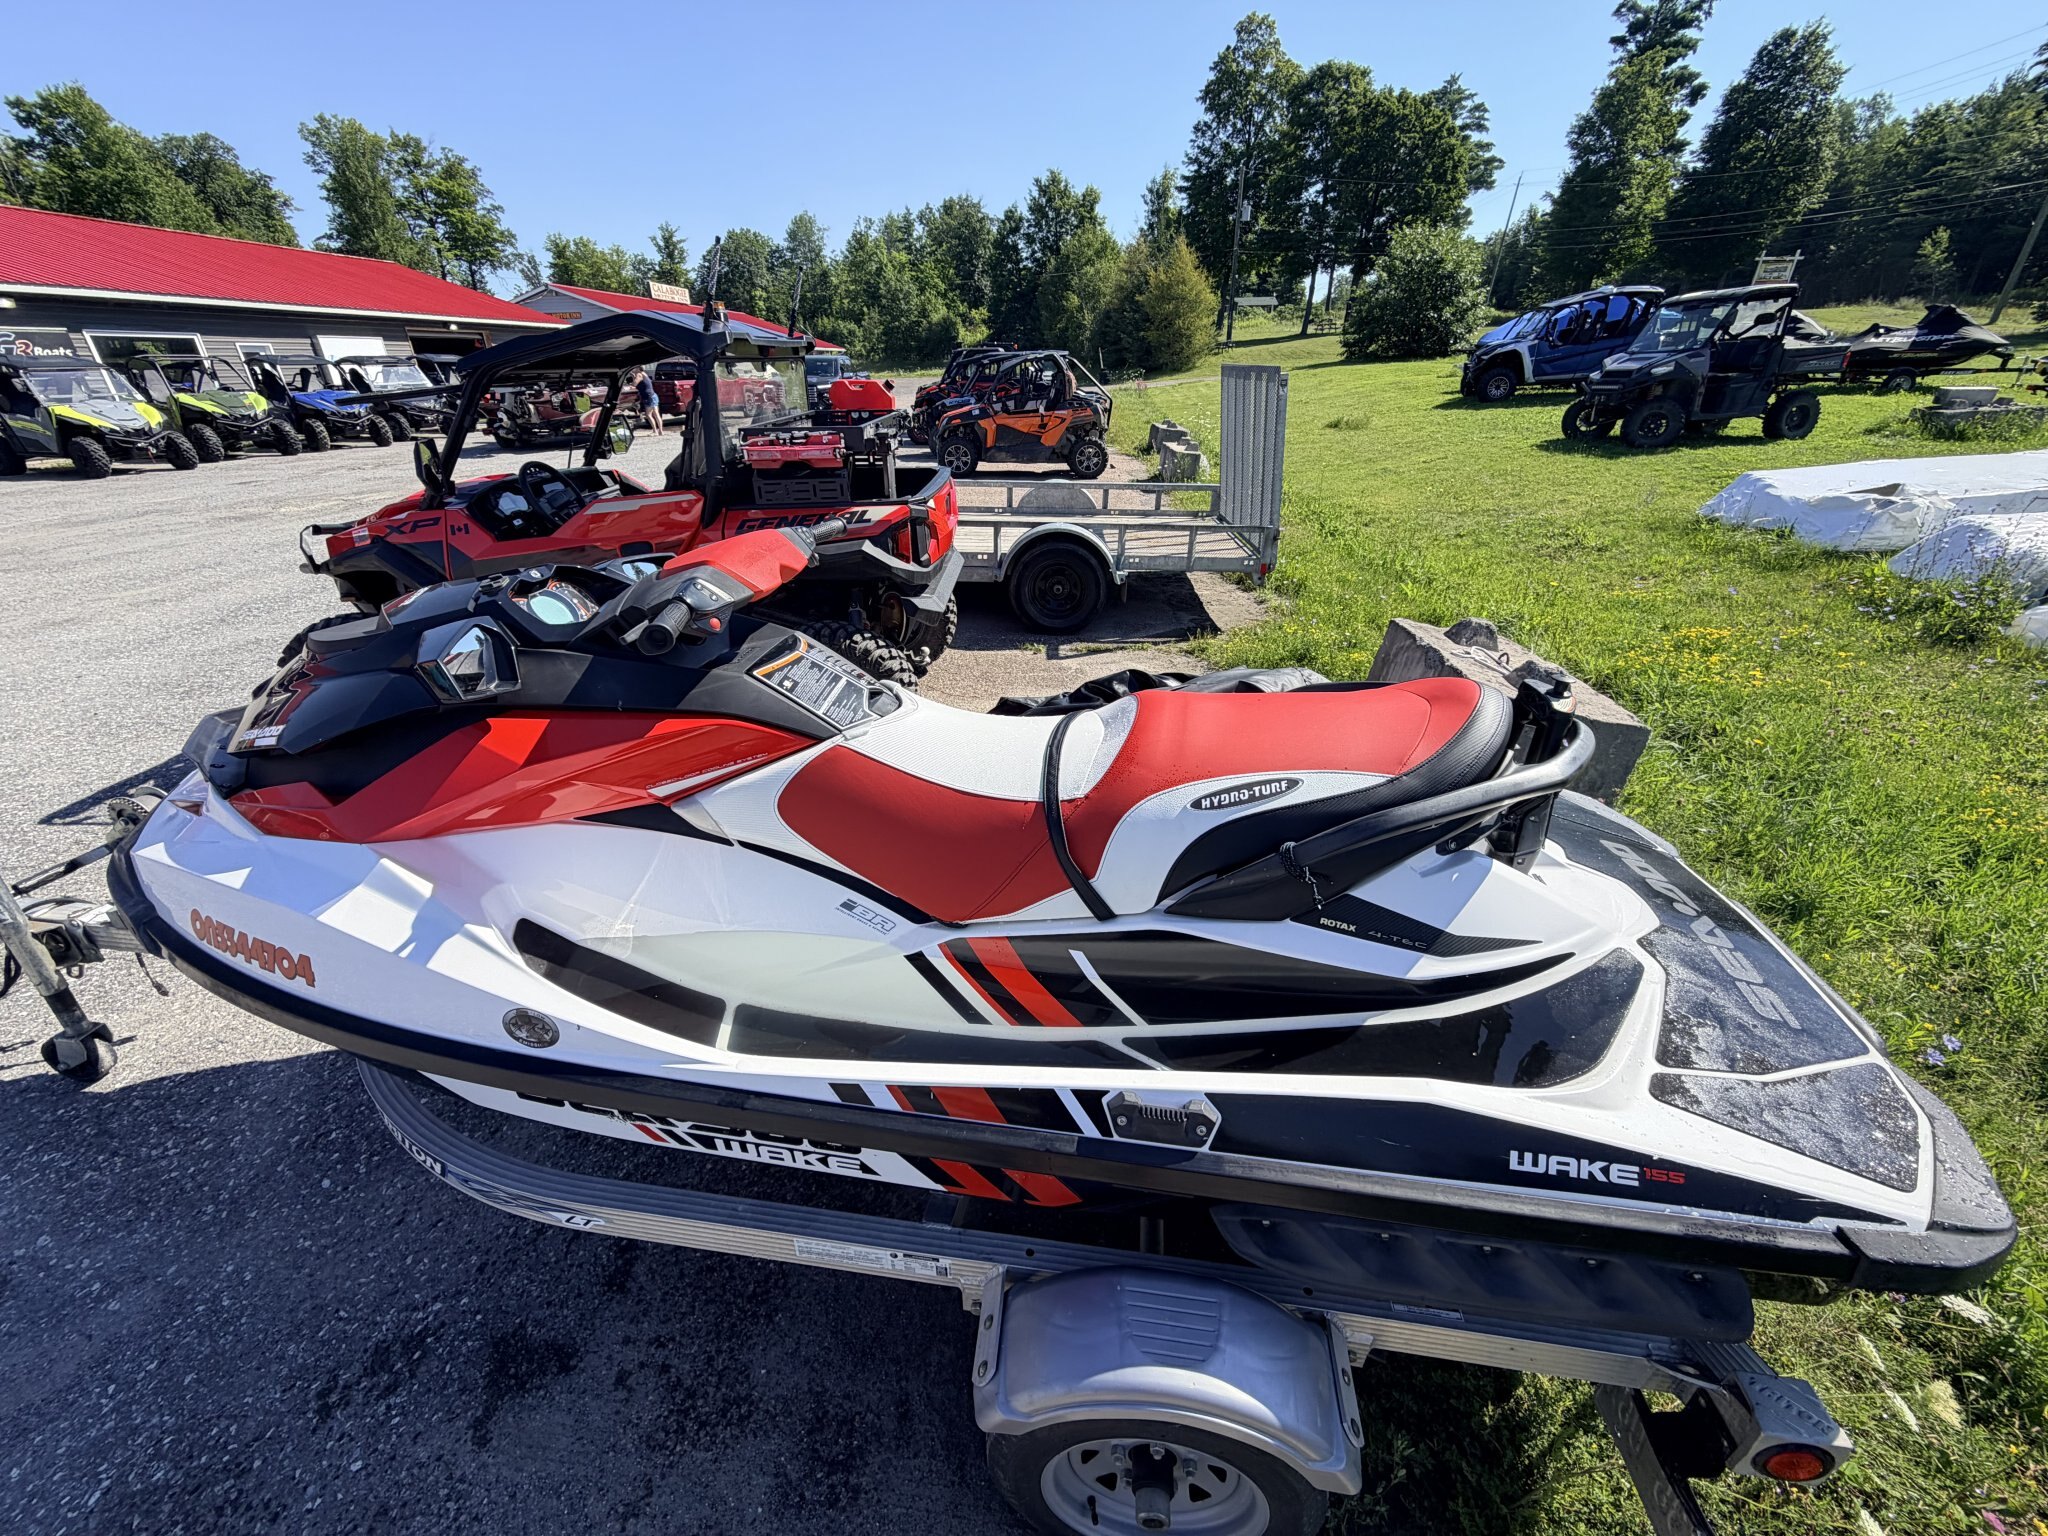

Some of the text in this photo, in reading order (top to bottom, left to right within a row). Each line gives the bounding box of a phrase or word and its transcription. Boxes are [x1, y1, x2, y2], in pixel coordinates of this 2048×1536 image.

[652, 283, 688, 298] CALABOGIE
[382, 517, 442, 539] XP
[1201, 780, 1289, 809] HYDRO-TURF
[1320, 917, 1428, 950] ROTAX 4-TEC
[713, 1138, 864, 1175] WAKE
[1509, 1150, 1686, 1187] WAKE 155
[564, 1215, 595, 1227] LT
